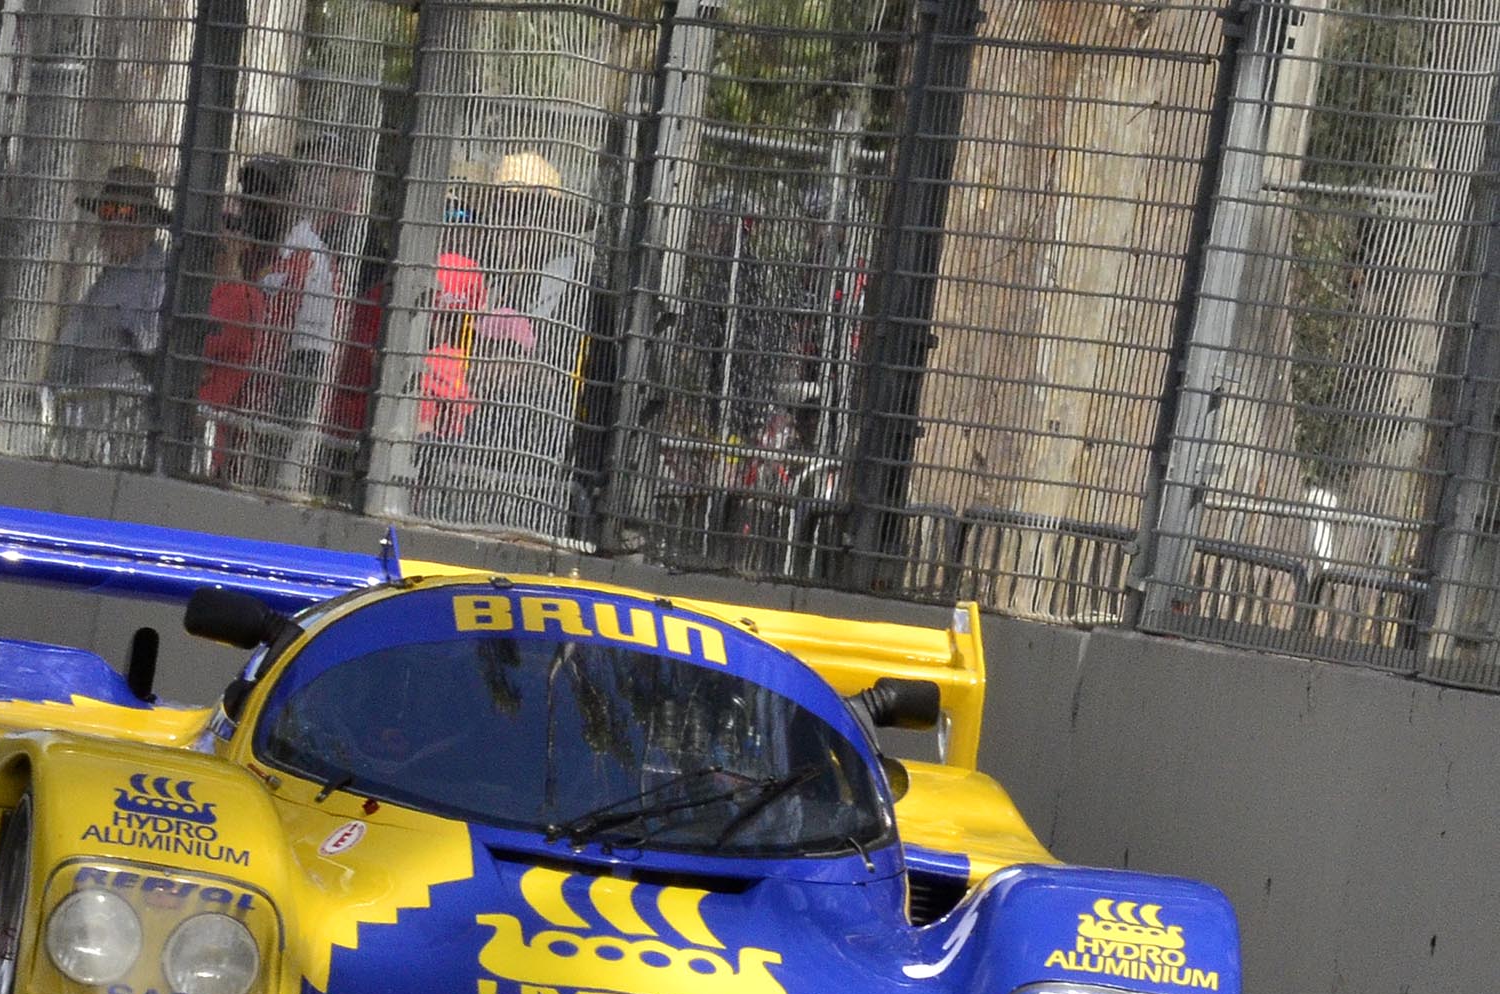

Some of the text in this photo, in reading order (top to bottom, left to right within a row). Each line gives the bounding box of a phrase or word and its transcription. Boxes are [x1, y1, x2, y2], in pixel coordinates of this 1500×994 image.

[81, 824, 250, 867] ALUMINIUM
[113, 811, 218, 842] HYDRO
[73, 867, 257, 910] REPSOL
[1044, 949, 1218, 991] ALUMINIUM
[1076, 936, 1186, 967] HYDRO
